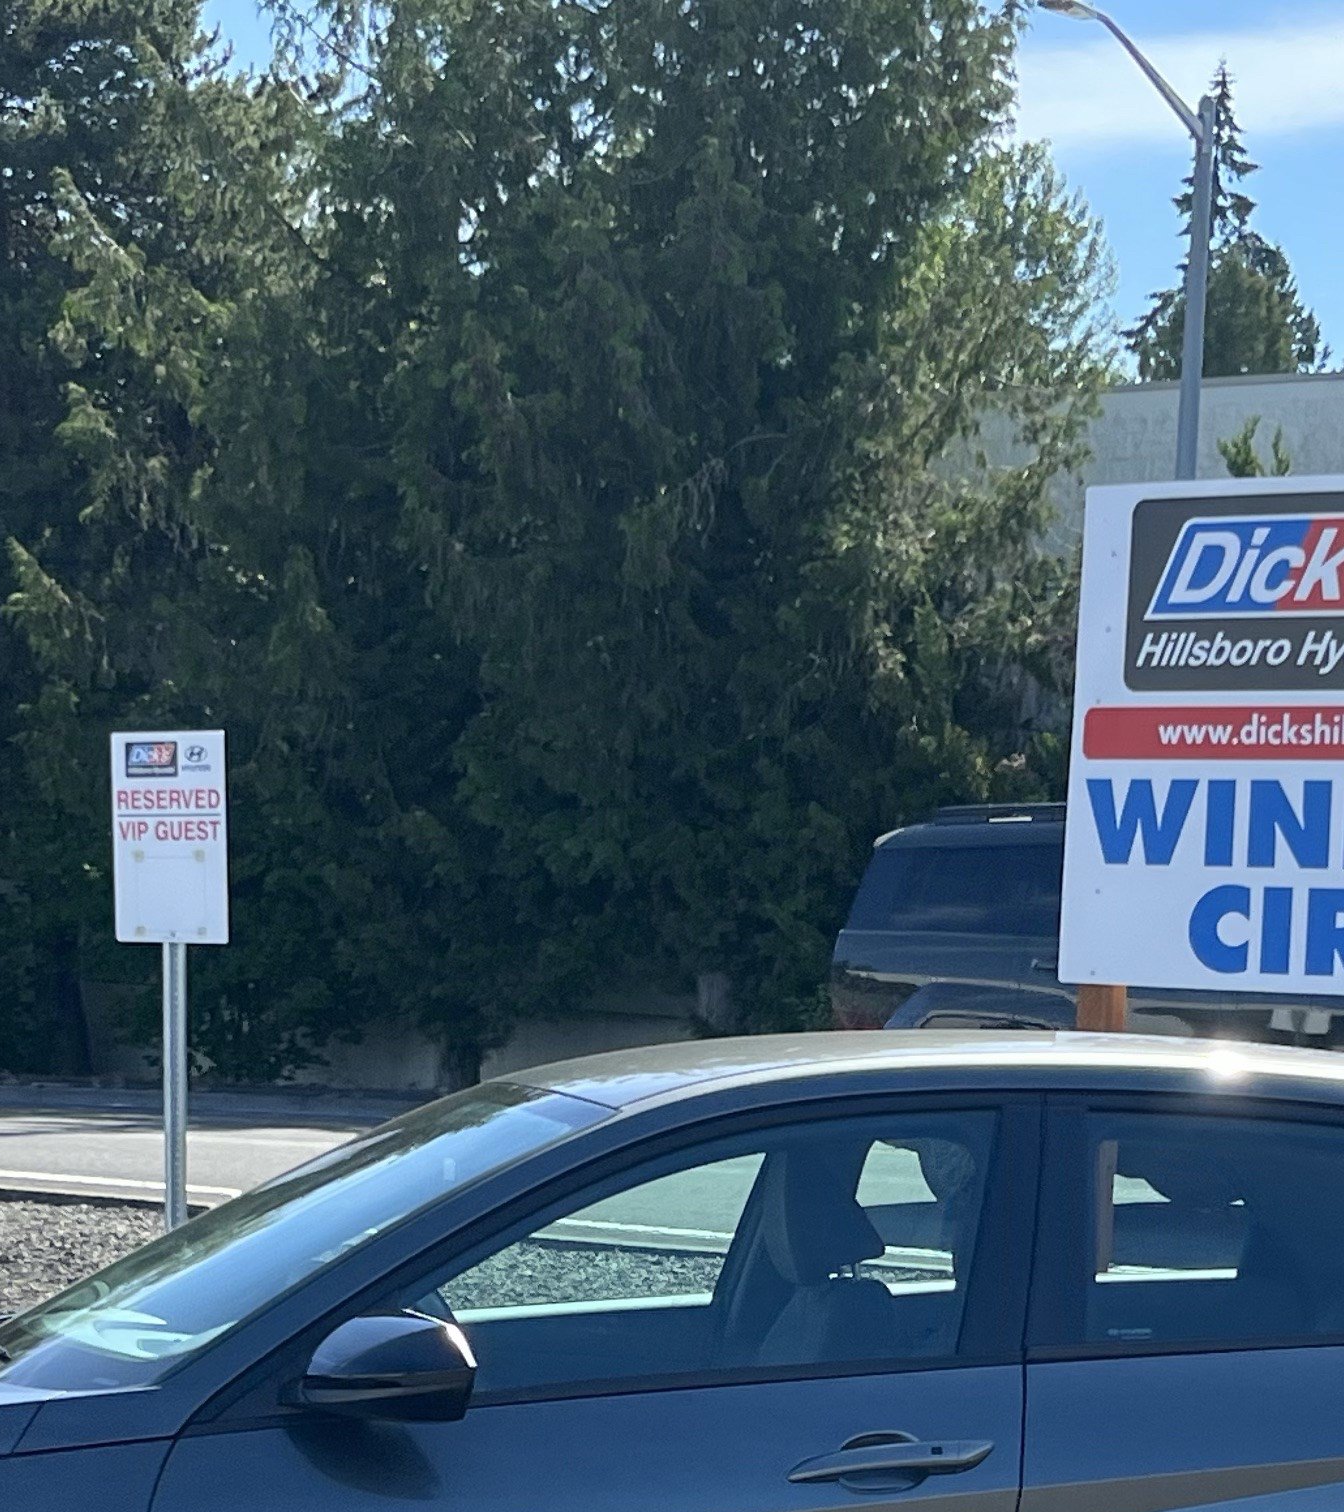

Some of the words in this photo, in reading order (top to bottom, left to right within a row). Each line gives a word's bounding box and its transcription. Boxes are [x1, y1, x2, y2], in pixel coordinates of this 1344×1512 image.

[1136, 630, 1292, 668] Hillsboro
[117, 789, 221, 809] RESERVED
[119, 821, 149, 841] VIP
[156, 820, 221, 841] GUEST
